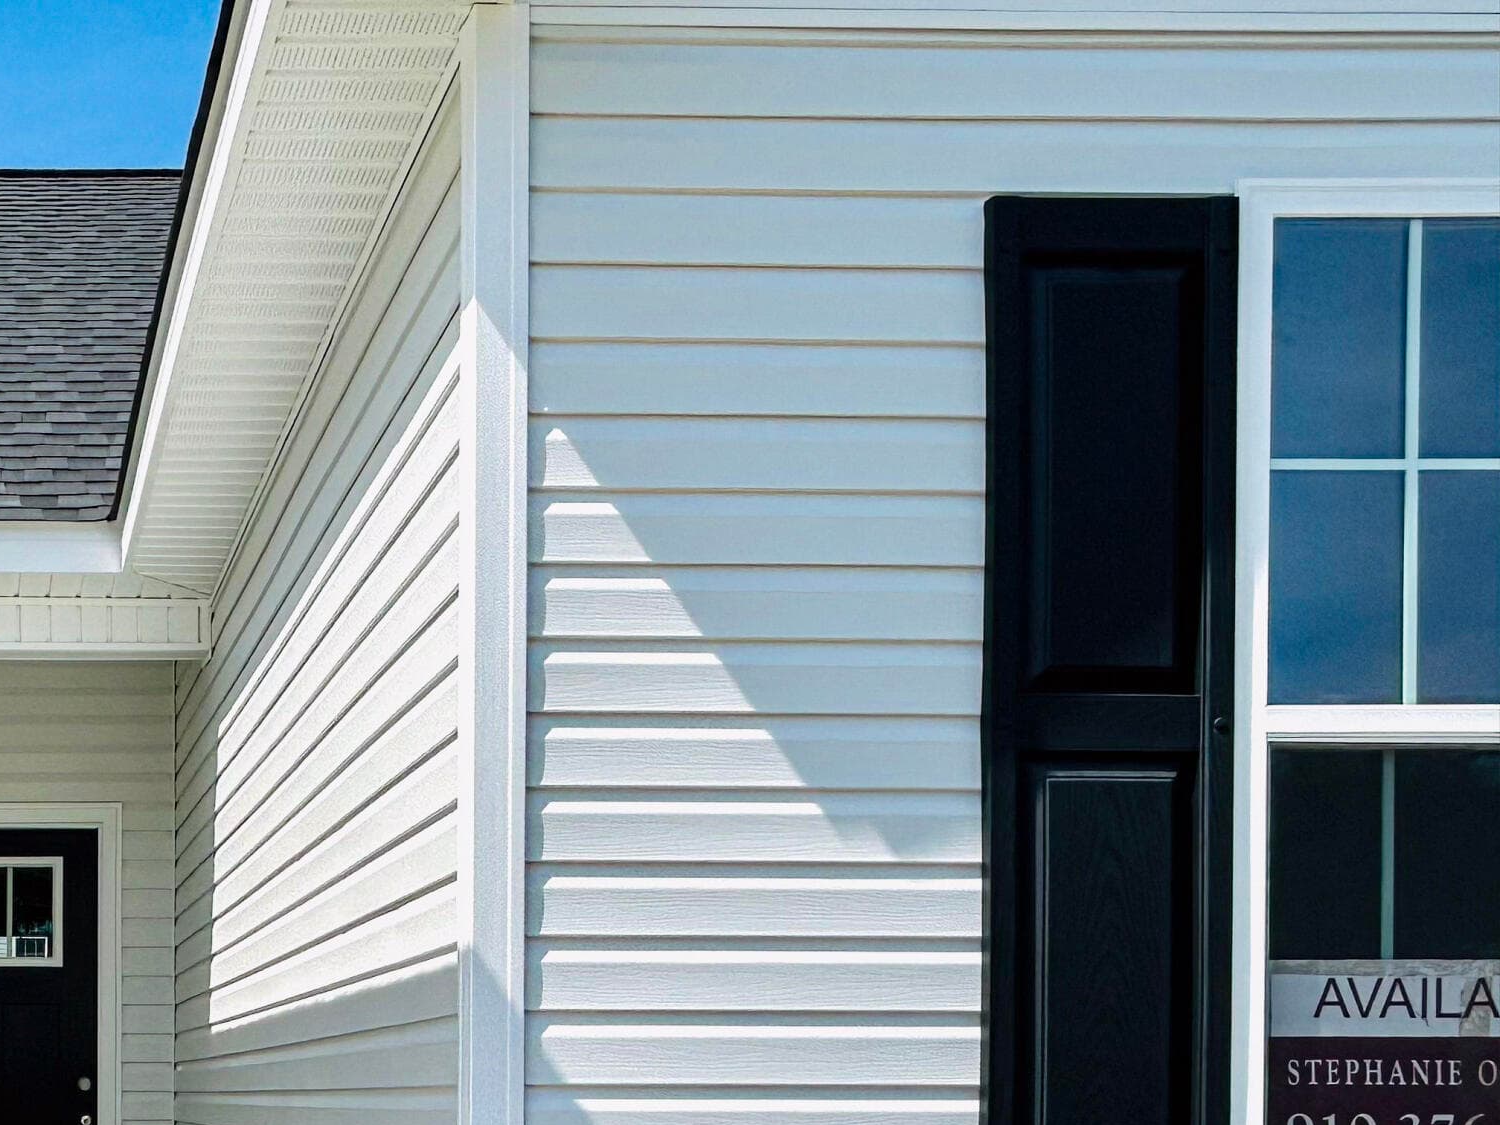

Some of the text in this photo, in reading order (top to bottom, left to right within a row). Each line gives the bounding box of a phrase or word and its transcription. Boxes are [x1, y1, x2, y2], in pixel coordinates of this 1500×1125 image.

[1313, 977, 1500, 1018] AVAILA
[1287, 1058, 1498, 1086] STEPHANIE O
